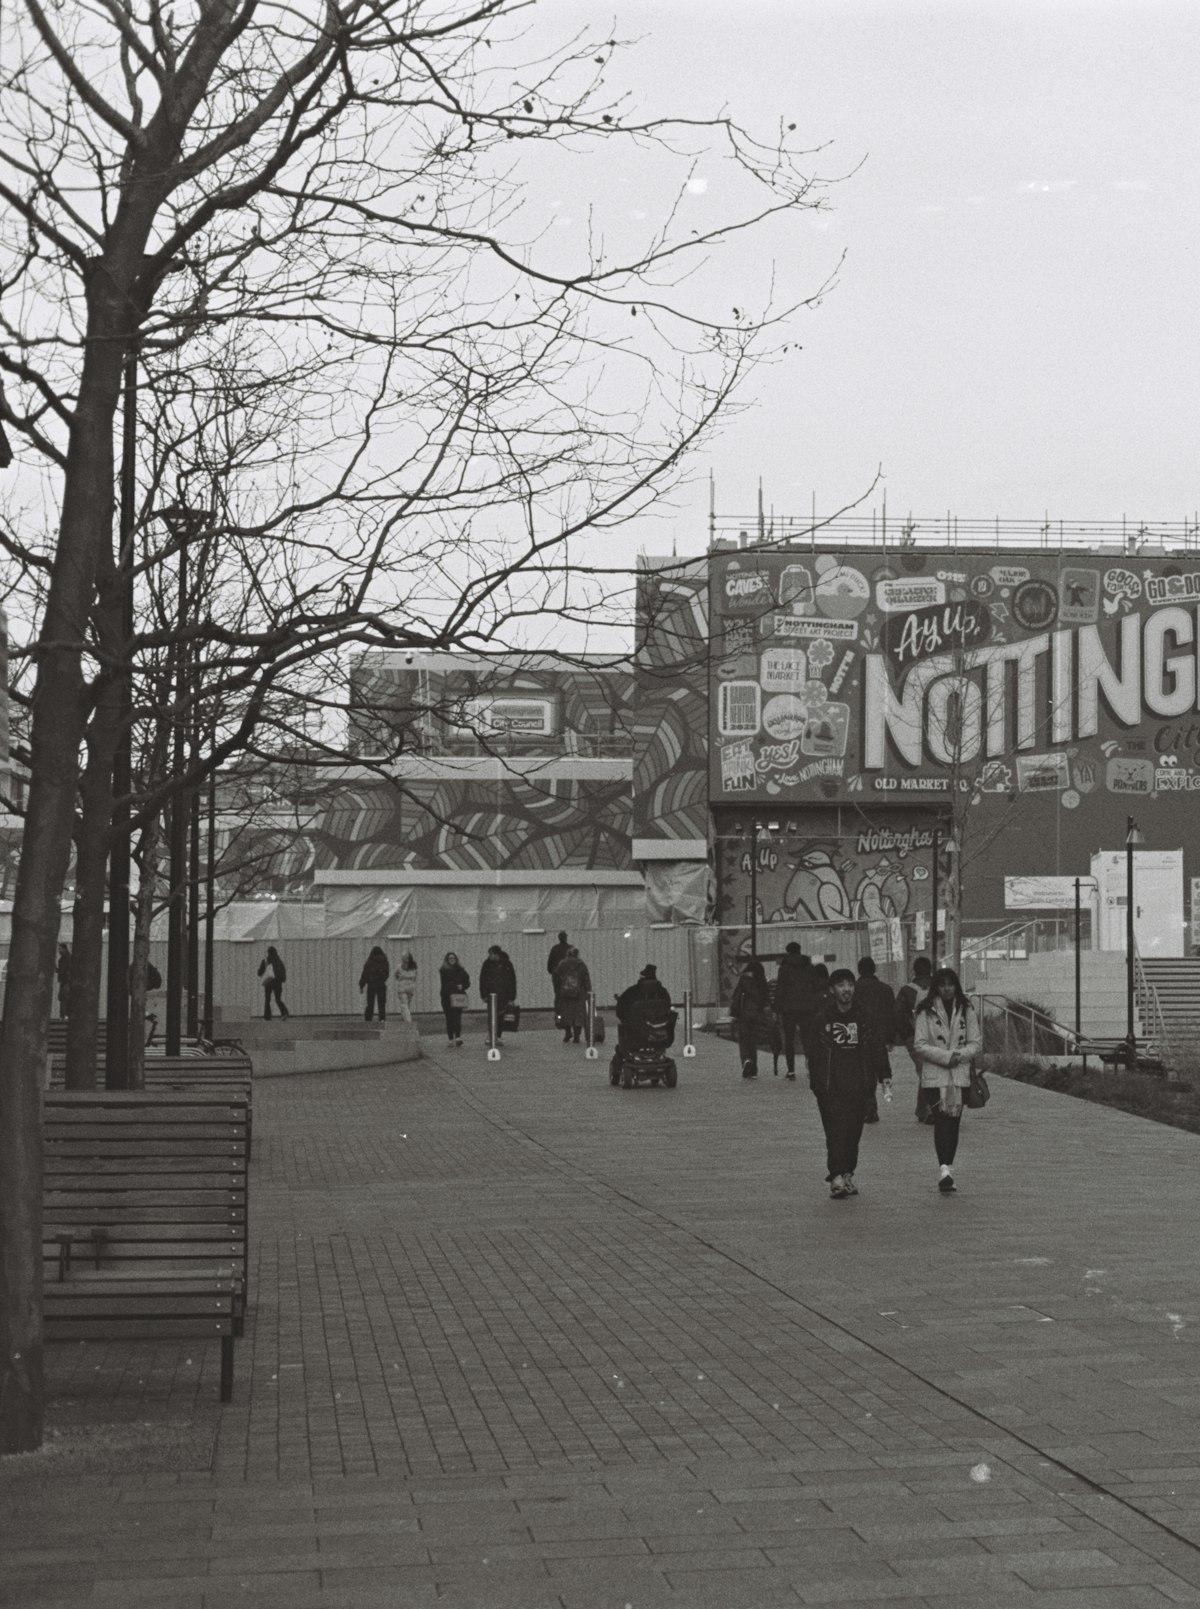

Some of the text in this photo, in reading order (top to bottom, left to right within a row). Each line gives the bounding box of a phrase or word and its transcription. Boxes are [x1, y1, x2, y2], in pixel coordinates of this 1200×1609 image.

[726, 577, 763, 596] CAVES
[1147, 579, 1166, 599] GO
[785, 620, 854, 629] NOTTINGHAM
[766, 671, 800, 681] MARKET
[510, 719, 544, 729] Council
[723, 772, 756, 791] FUN
[875, 778, 898, 790] OLD
[901, 778, 949, 790] MARKET
[759, 848, 778, 869] Up
